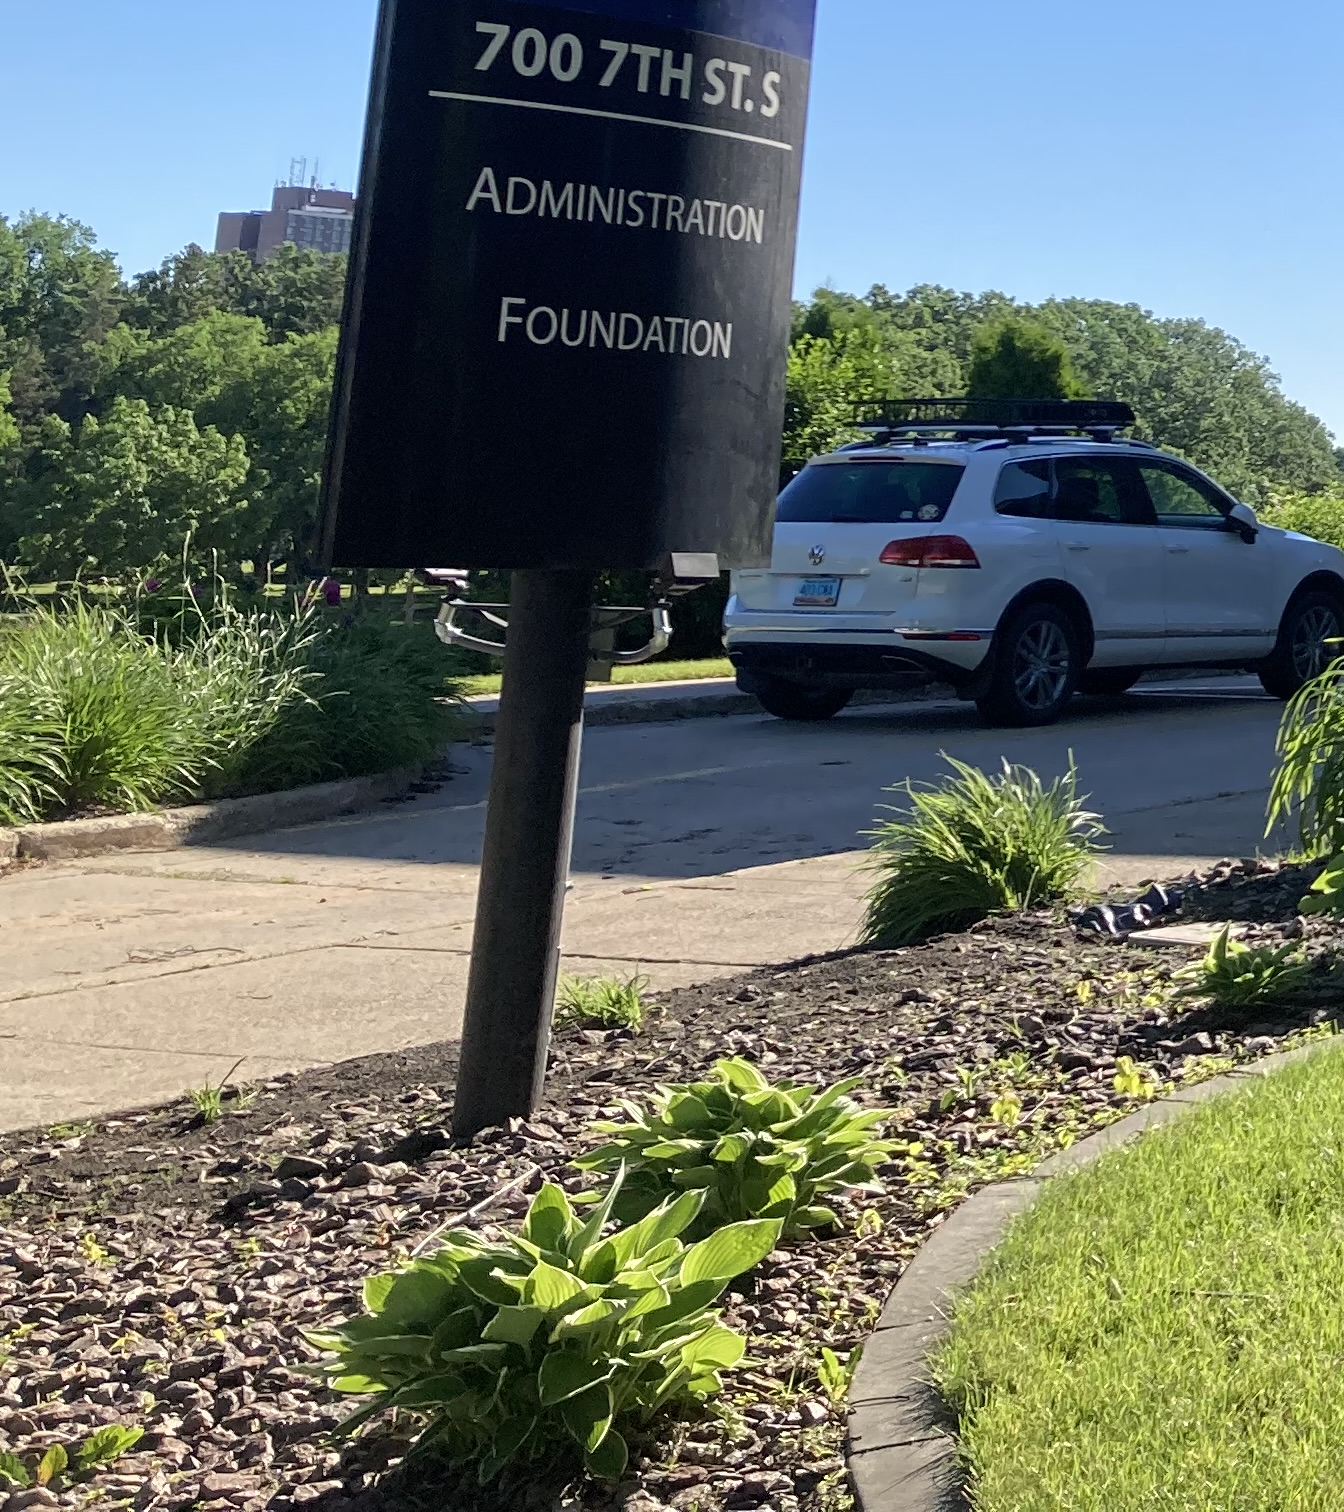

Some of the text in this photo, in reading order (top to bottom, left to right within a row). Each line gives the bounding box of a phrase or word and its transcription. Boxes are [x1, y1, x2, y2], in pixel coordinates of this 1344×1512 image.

[474, 21, 584, 82] 700
[598, 40, 693, 100] 7TH
[465, 167, 765, 244] ADMINISTRATION
[498, 296, 733, 359] FOUNDATION
